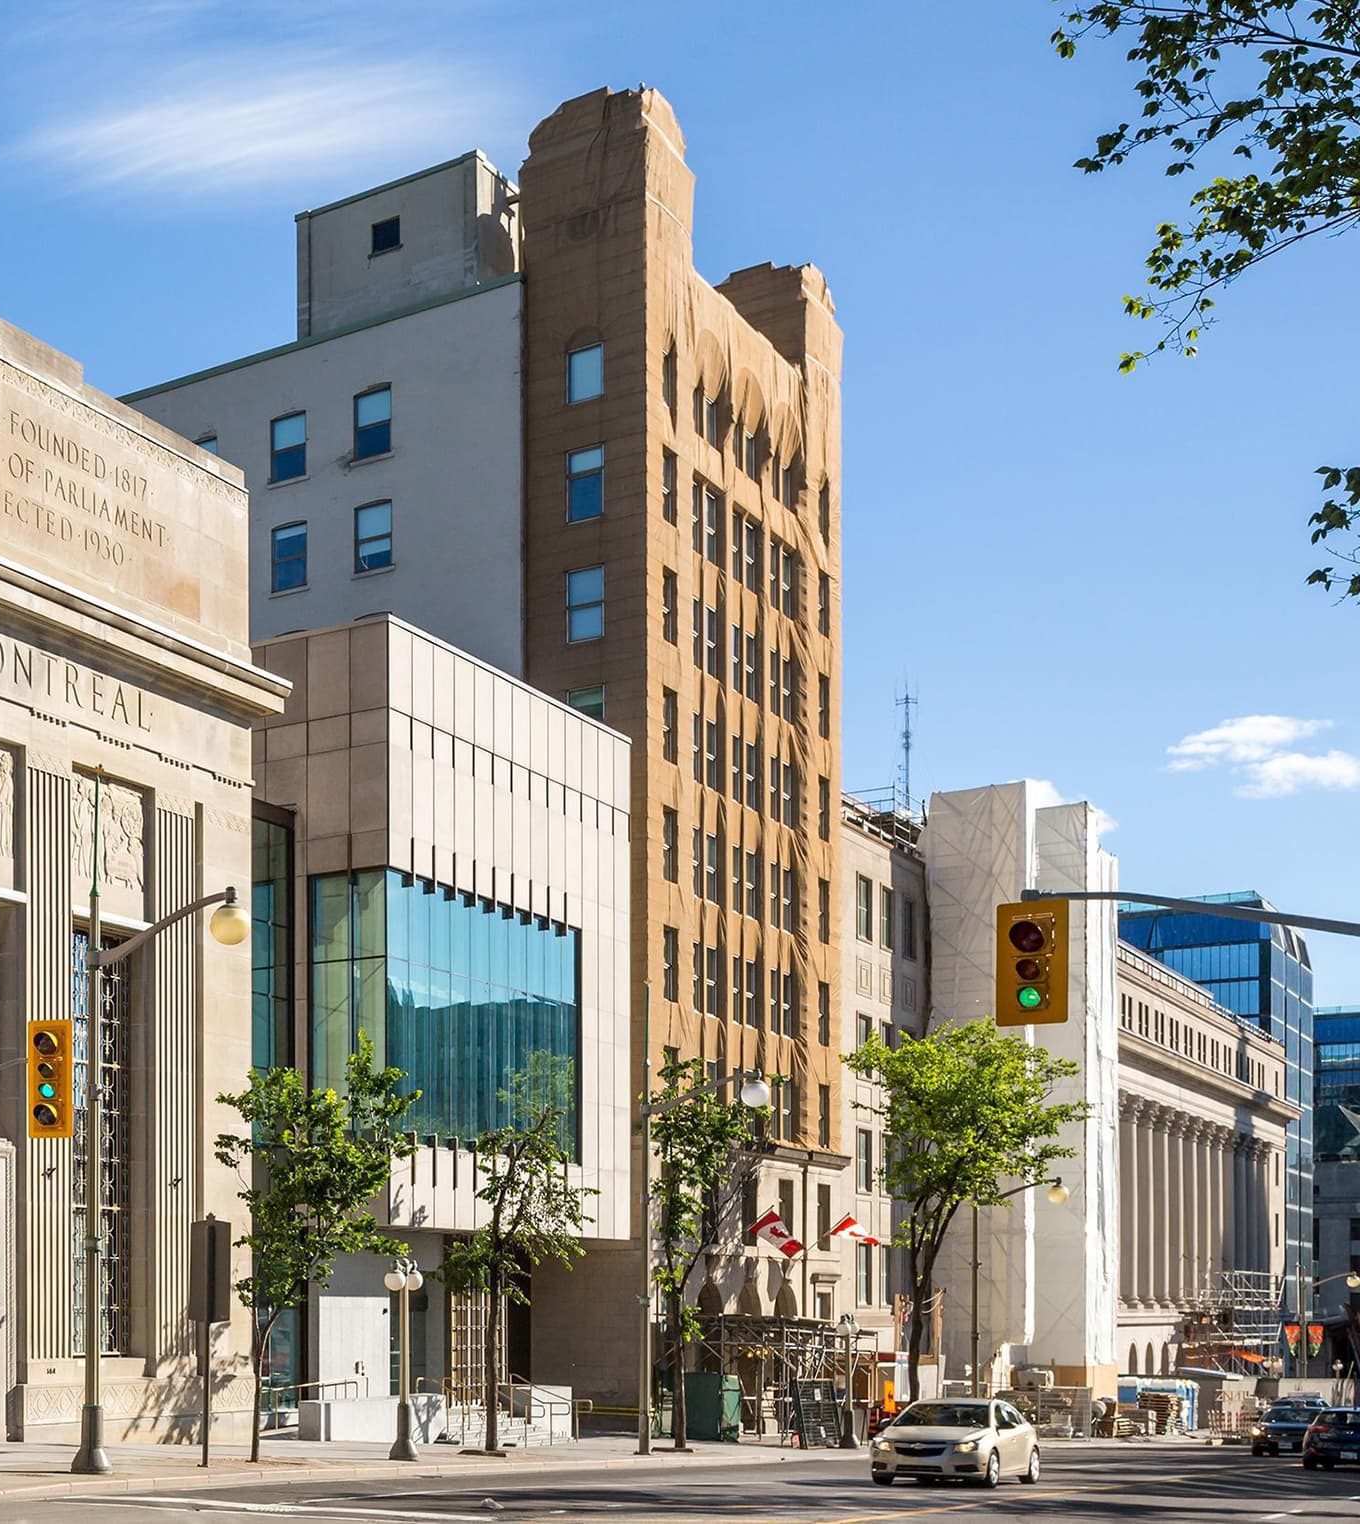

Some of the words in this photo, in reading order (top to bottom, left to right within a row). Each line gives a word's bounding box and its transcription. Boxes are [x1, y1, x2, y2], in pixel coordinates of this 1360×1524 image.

[8, 452, 35, 484] OF
[44, 468, 167, 548] PARLIAMENT
[9, 410, 106, 480] FOUNDED
[115, 465, 148, 501] 1817
[84, 528, 125, 567] 1930
